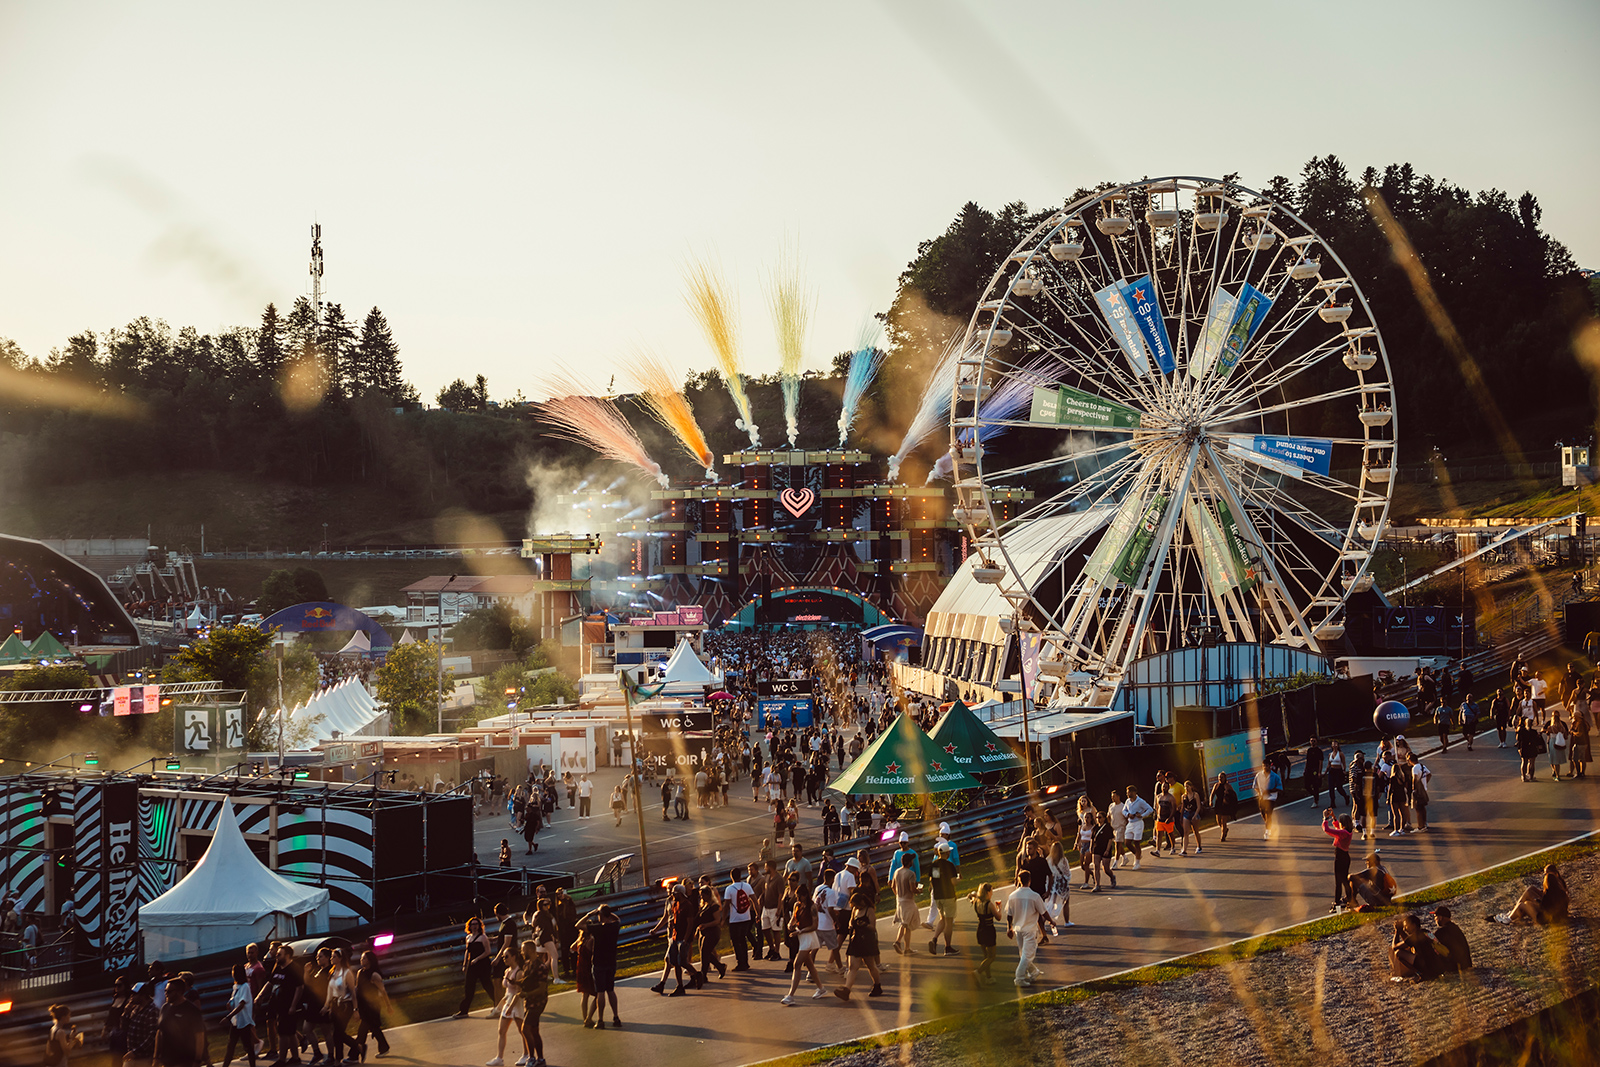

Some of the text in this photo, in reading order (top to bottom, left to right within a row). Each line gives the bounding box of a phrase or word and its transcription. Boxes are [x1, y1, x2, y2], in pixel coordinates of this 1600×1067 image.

[1146, 315, 1167, 358] Heineken
[1066, 397, 1089, 409] Cheers
[1097, 404, 1113, 413] new
[1067, 407, 1109, 421] perspectives
[1275, 440, 1326, 456] one more round
[1284, 450, 1292, 458] to
[1292, 453, 1315, 464] Cheers
[301, 619, 336, 628] Red Bull
[771, 684, 789, 692] WC
[660, 717, 681, 728] WC
[1206, 744, 1230, 758] SAFETY
[1230, 743, 1236, 753] &
[980, 752, 1018, 763] Heineken
[1207, 752, 1245, 770] EMERGENCY
[865, 775, 915, 784] Heineken
[926, 772, 965, 783] Heineken
